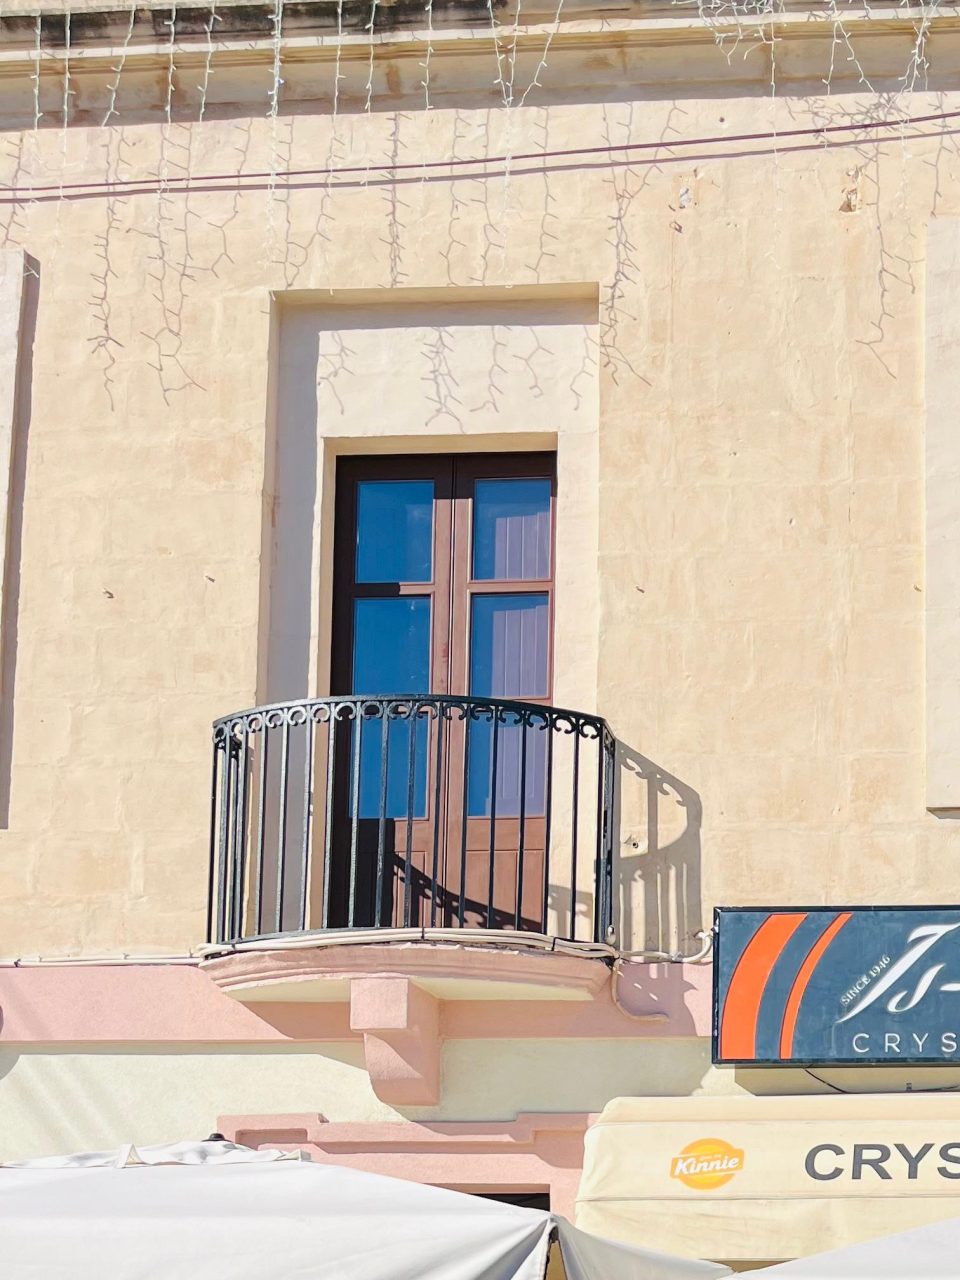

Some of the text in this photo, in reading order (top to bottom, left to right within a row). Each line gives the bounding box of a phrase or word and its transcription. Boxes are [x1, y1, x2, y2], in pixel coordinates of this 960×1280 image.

[840, 953, 891, 1006] SINCE 1946
[673, 1155, 740, 1176] Kinnie
